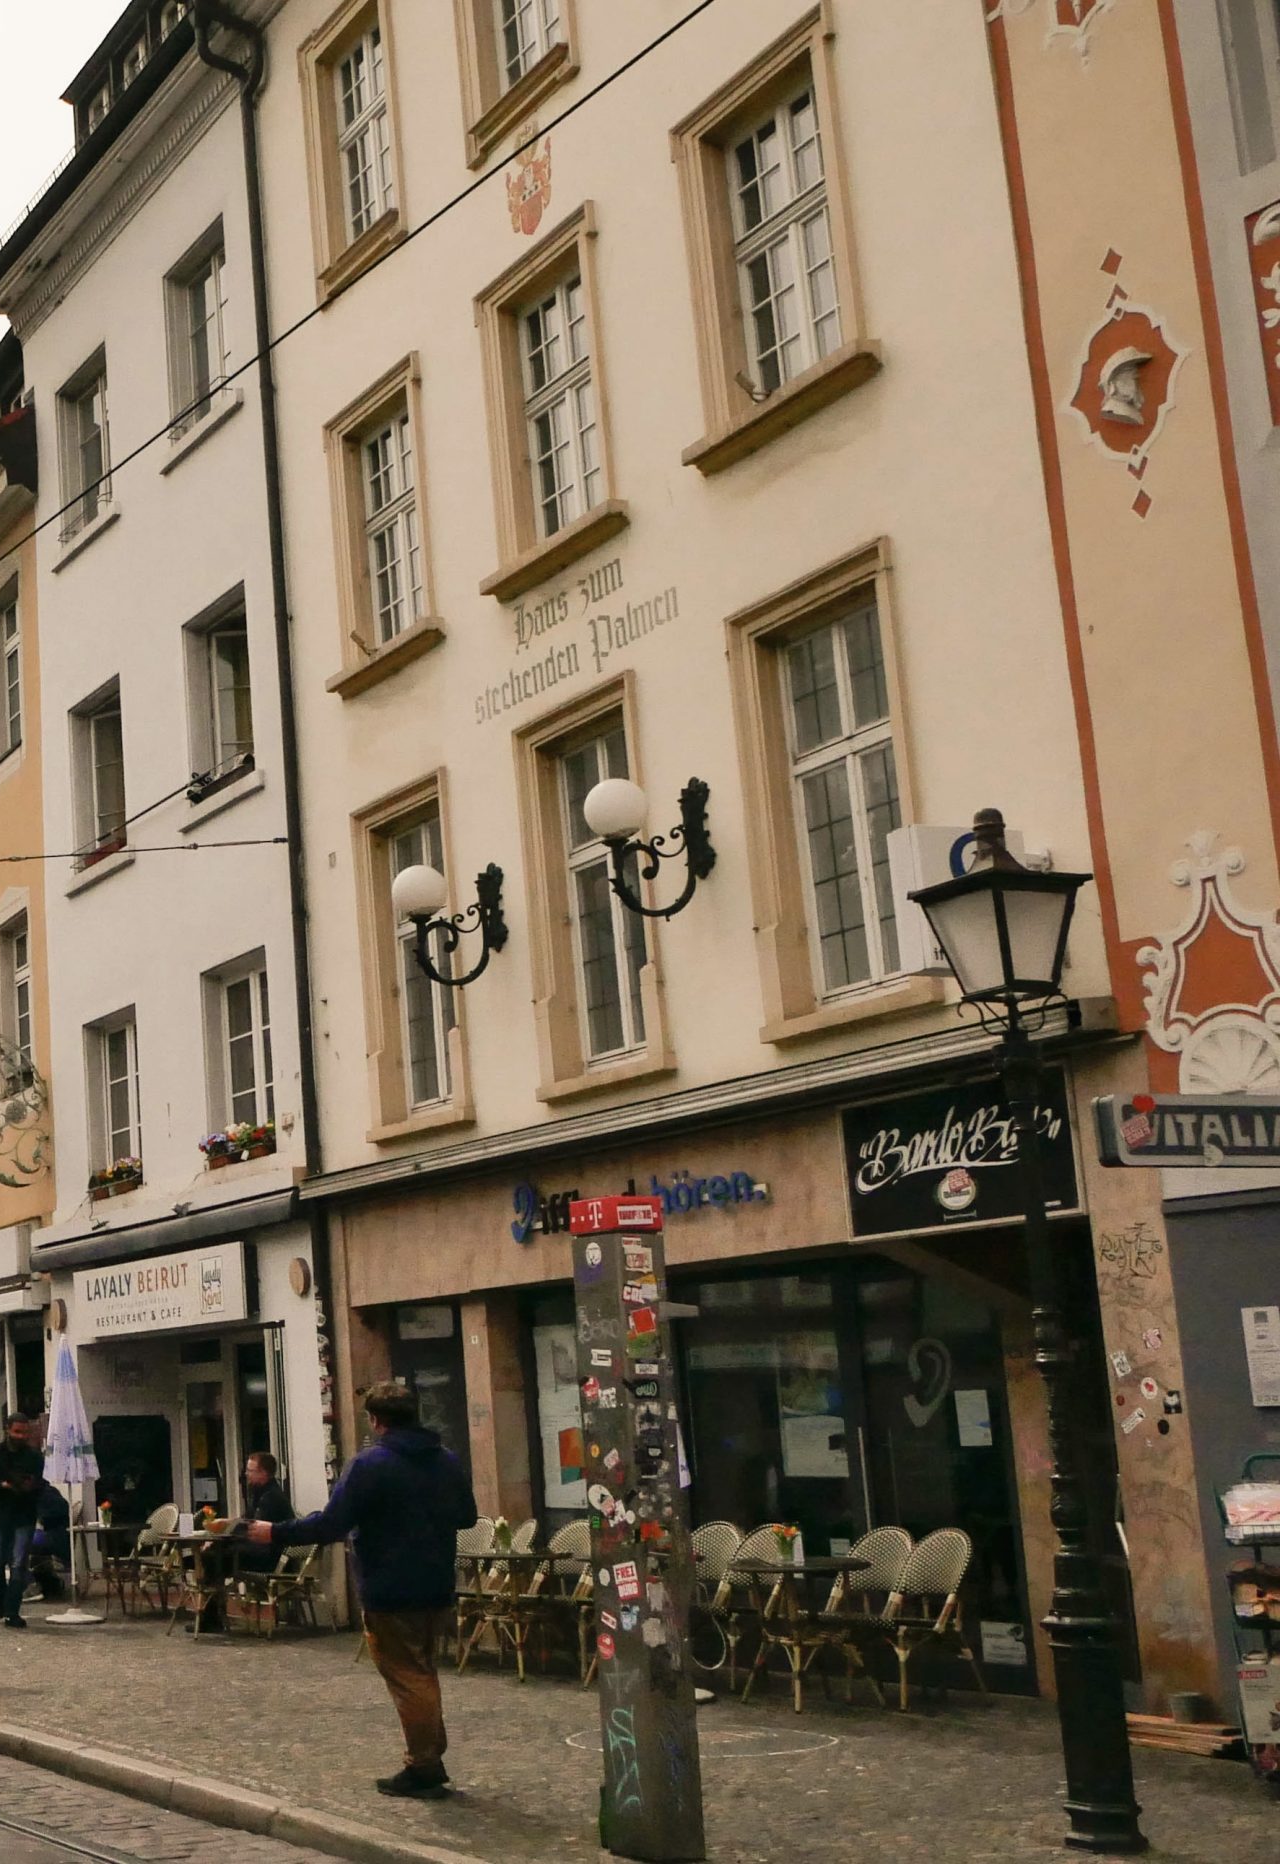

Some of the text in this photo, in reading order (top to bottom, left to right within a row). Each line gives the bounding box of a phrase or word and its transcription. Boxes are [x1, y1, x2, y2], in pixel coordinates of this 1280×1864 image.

[514, 558, 624, 655] Haus zum
[475, 586, 680, 724] stechenden Palmen
[1130, 1113, 1280, 1147] ITALI
[86, 1262, 188, 1302] LAYALY BEIRUT
[96, 1312, 147, 1328] RESTAURANT
[151, 1309, 156, 1321] &
[615, 1565, 635, 1580] FREI
